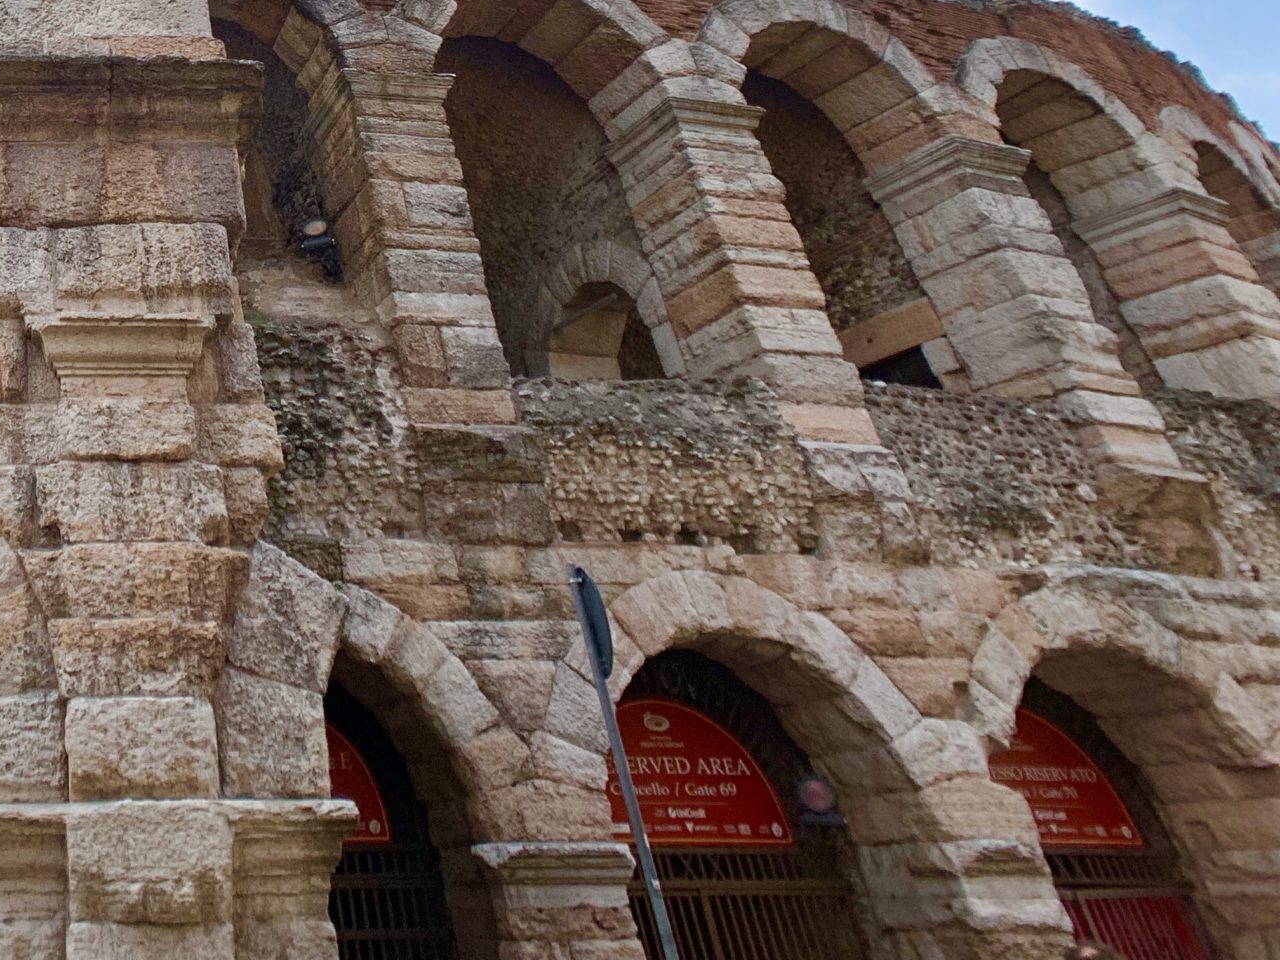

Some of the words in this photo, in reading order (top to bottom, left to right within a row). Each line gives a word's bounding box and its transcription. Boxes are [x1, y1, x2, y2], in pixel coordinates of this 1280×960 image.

[607, 755, 691, 776] EERVED
[697, 757, 751, 777] AREA
[610, 782, 670, 797] Cncello
[684, 782, 717, 797] Gate
[719, 782, 737, 797] 69
